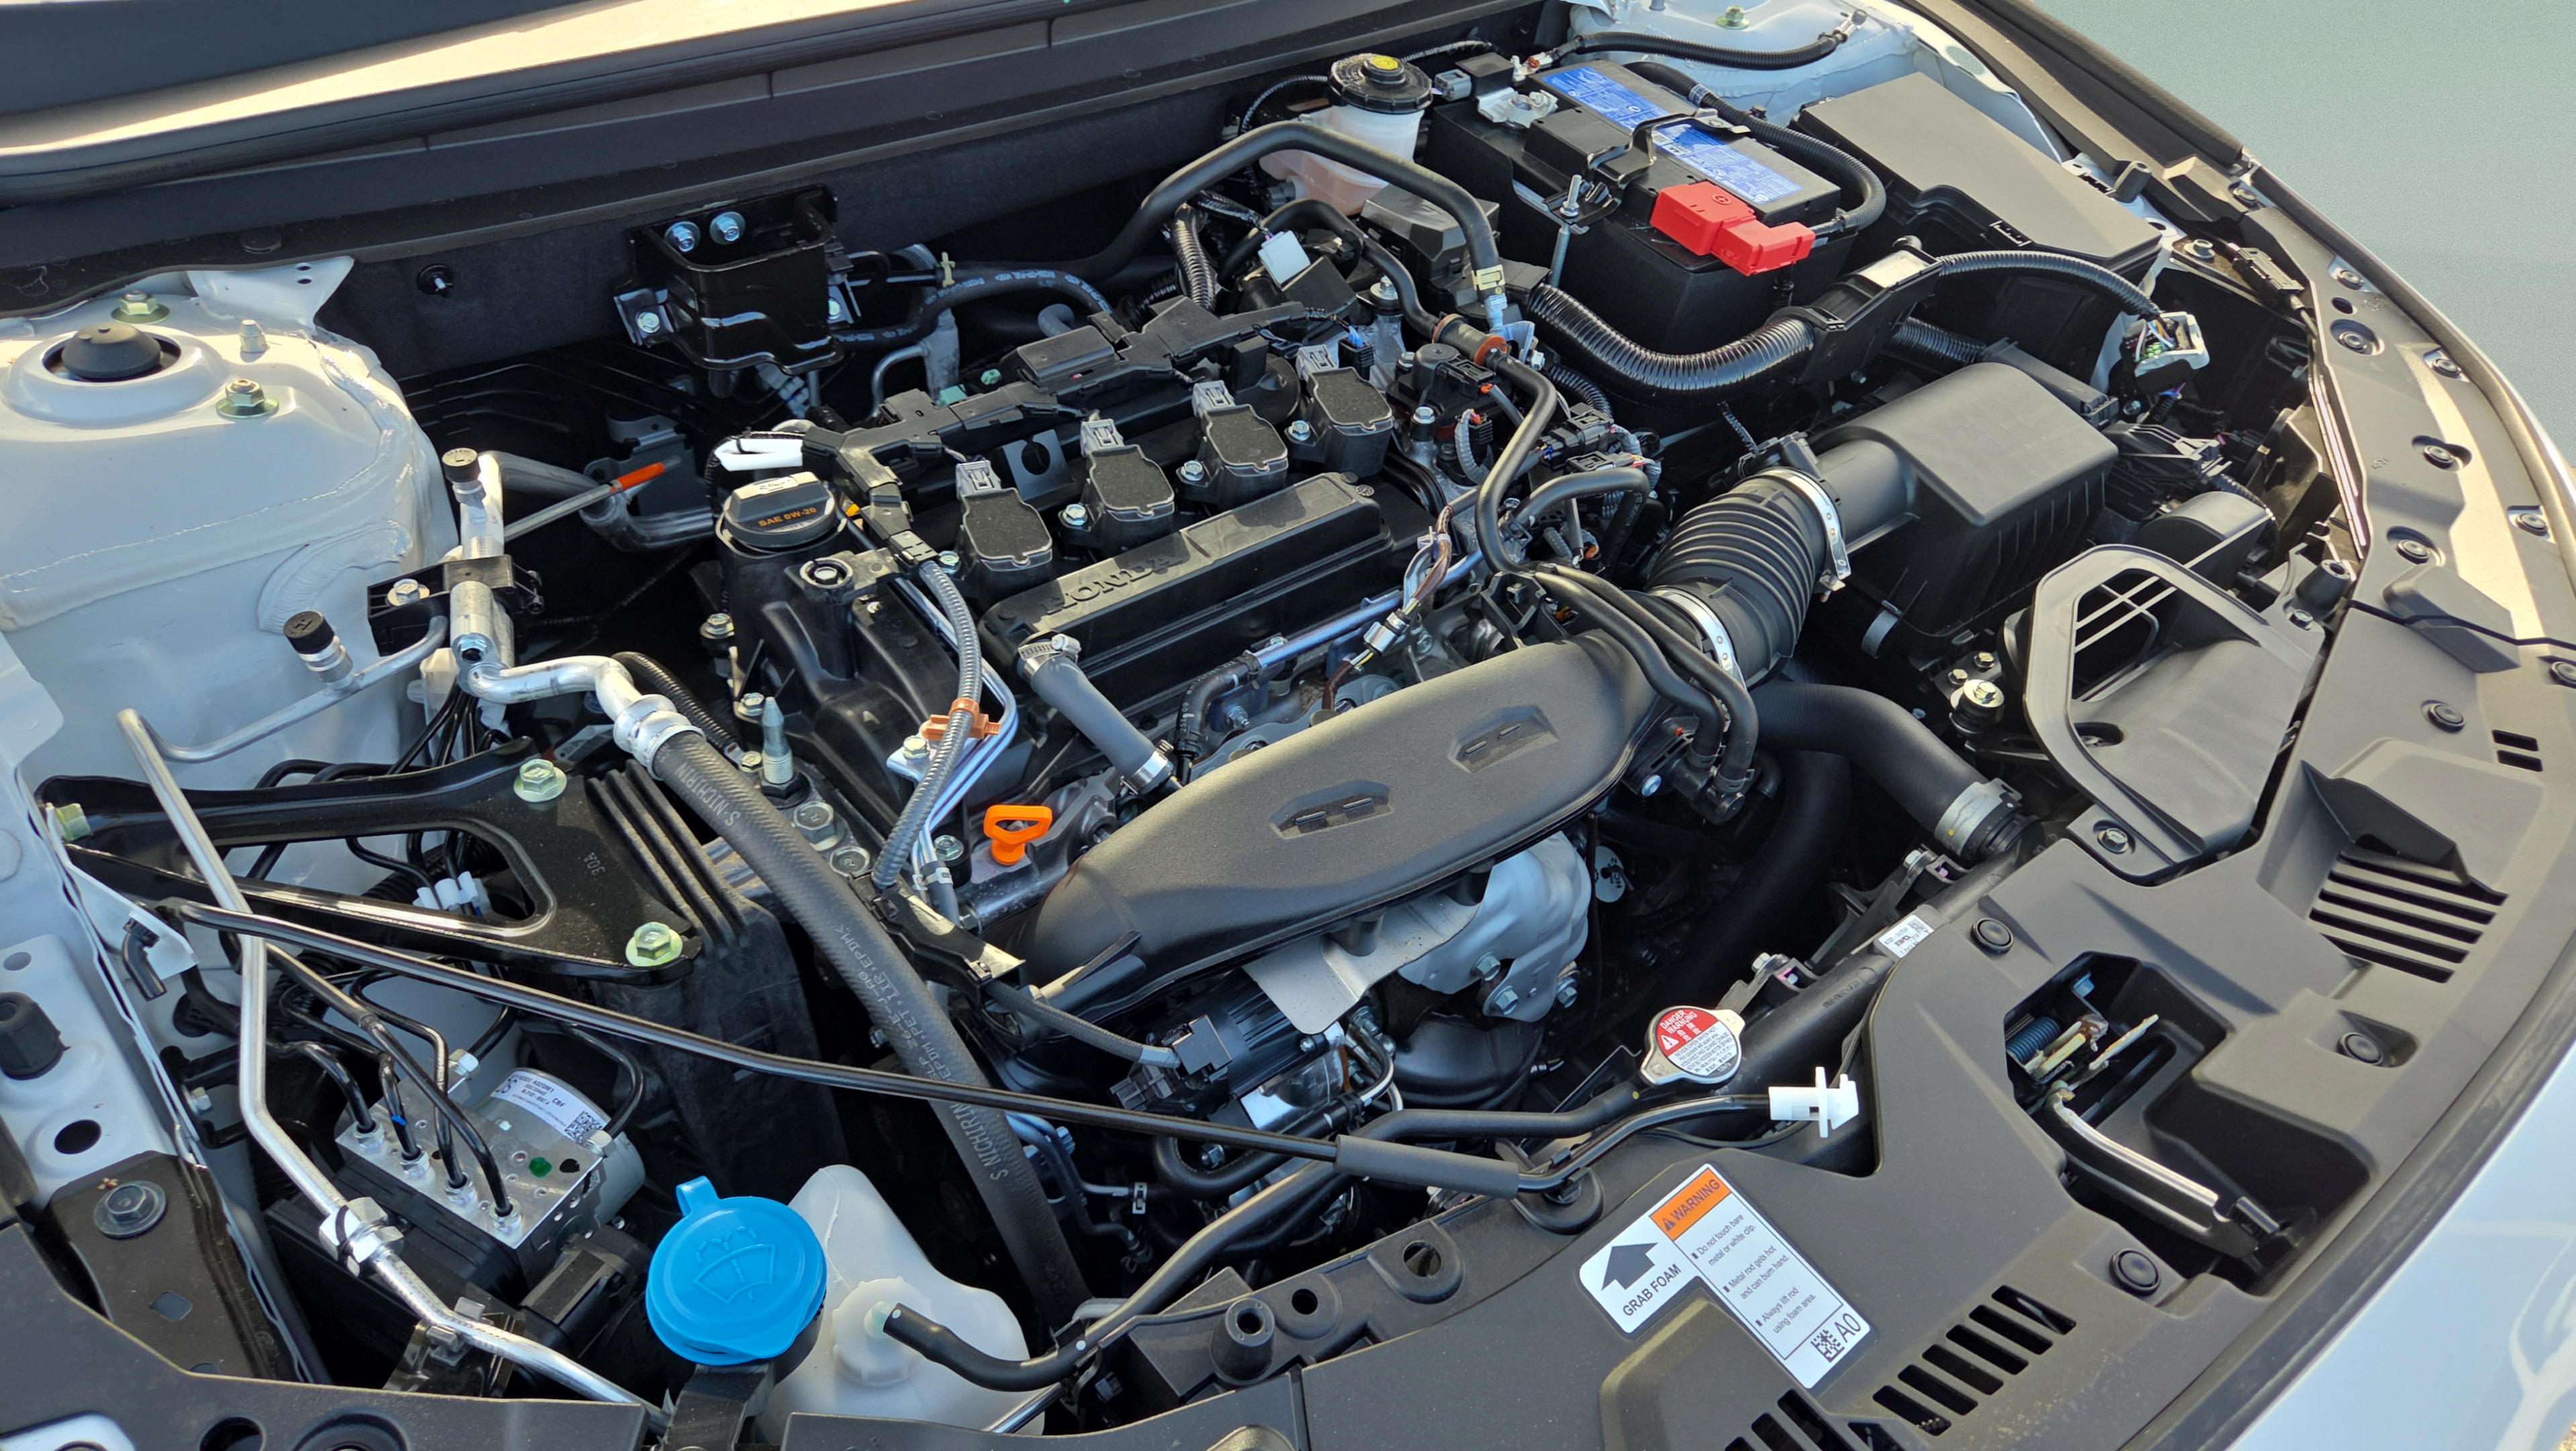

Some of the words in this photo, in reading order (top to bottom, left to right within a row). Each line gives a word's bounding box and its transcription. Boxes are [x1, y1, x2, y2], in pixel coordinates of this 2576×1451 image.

[757, 516, 782, 527] SAE
[784, 507, 817, 520] 0W-20
[1041, 557, 1183, 615] HONDA
[1659, 1010, 1688, 1029] DANGER
[1665, 1012, 1698, 1034] WARNUNG
[551, 1097, 567, 1108] CBF
[1669, 1178, 1720, 1222] WARNING
[1697, 1244, 1708, 1255] Do
[1706, 1236, 1716, 1248] not
[1715, 1223, 1732, 1240] touch
[1729, 1214, 1744, 1228] bare
[1708, 1250, 1725, 1266] metal
[1723, 1244, 1731, 1254] or
[1730, 1232, 1745, 1248] white
[1744, 1224, 1757, 1237] clip.
[1728, 1272, 1746, 1288] Metal
[1745, 1263, 1755, 1275] rod
[1754, 1254, 1767, 1268] gets
[1765, 1245, 1777, 1257] hot
[1740, 1286, 1753, 1300] and
[1751, 1276, 1763, 1288] can
[1761, 1266, 1776, 1281] burn
[1773, 1254, 1790, 1270] hand.
[1622, 1288, 1653, 1317] GRAB
[1650, 1263, 1682, 1292] FOAM
[1761, 1303, 1783, 1323] Always
[1780, 1294, 1791, 1307] lift
[1788, 1286, 1800, 1297] rod
[1773, 1318, 1789, 1334] using
[1787, 1303, 1804, 1319] foam
[1802, 1294, 1817, 1308] area.
[1834, 1312, 1861, 1344] A0
